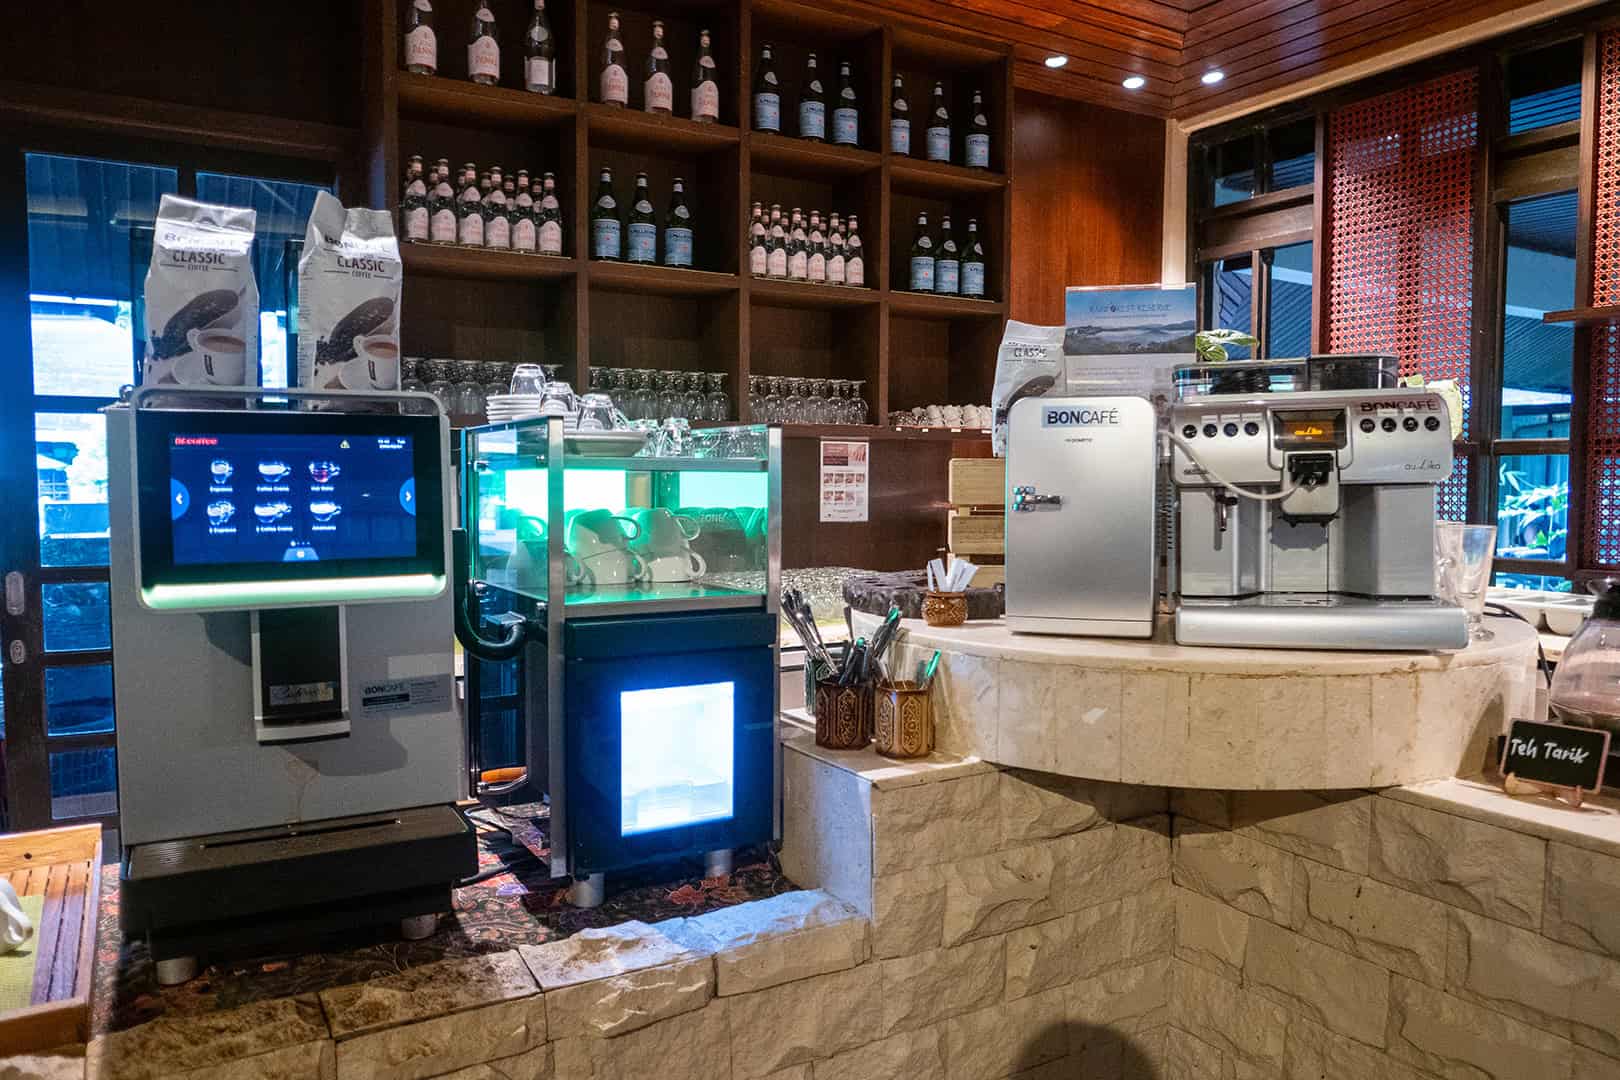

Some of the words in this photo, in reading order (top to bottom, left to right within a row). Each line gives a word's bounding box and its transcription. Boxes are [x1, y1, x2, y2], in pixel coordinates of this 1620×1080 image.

[172, 249, 225, 265] CLASSIC
[337, 255, 385, 272] CLASSIC
[1360, 398, 1438, 412] BONCAFÉ
[1046, 408, 1119, 424] BONCAFÉ
[1511, 738, 1538, 759] Teh
[1544, 742, 1590, 764] Tarik
